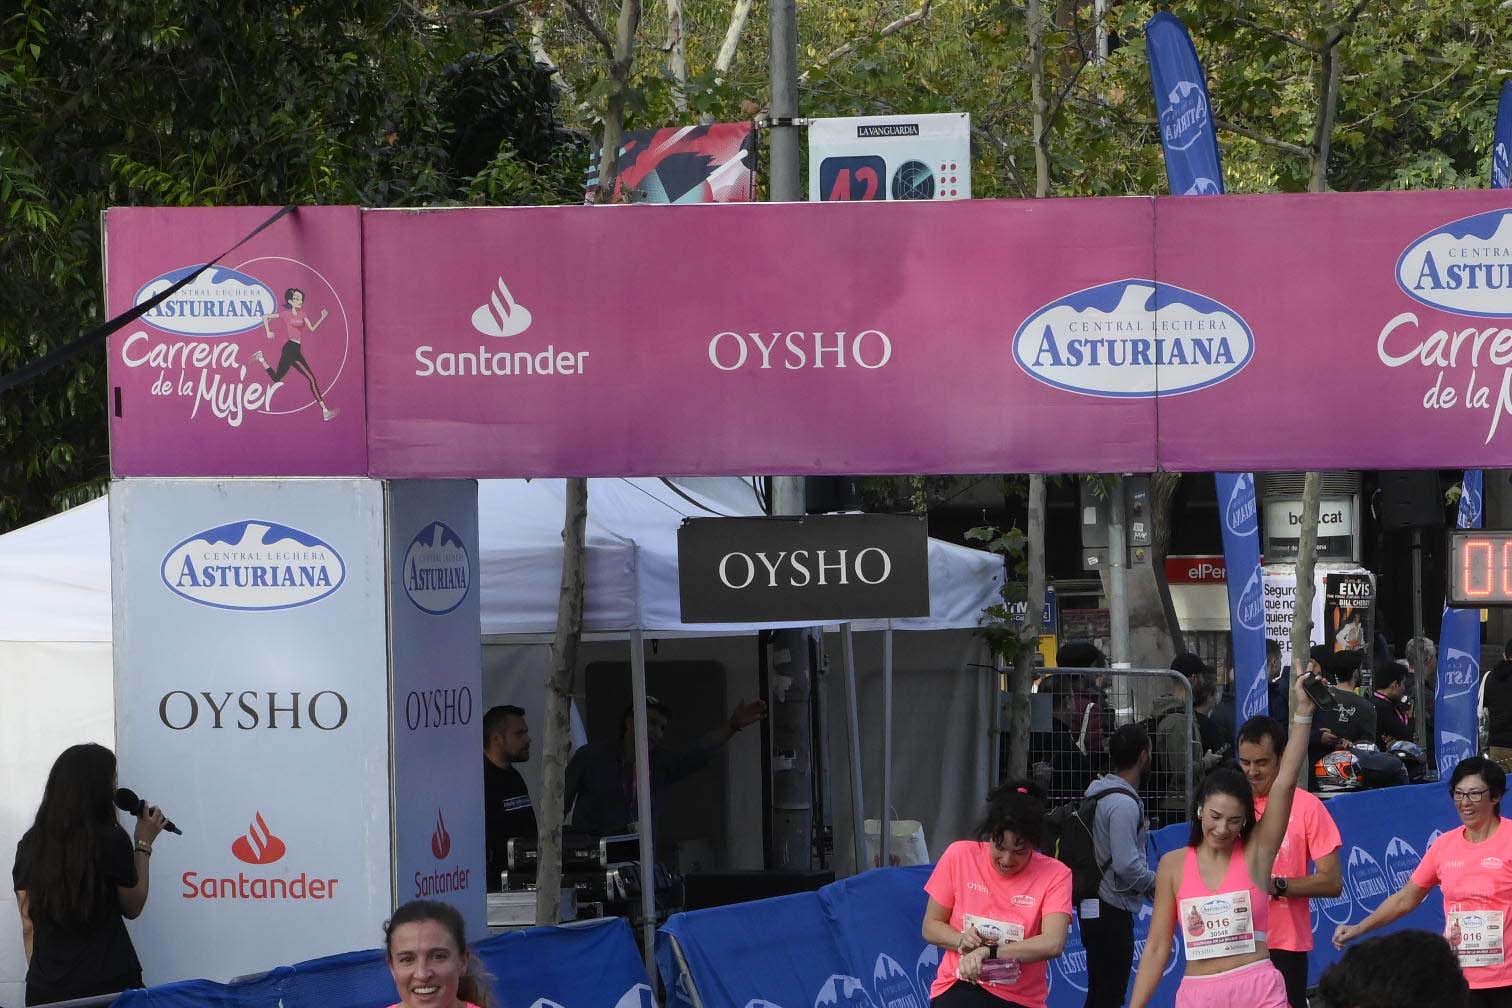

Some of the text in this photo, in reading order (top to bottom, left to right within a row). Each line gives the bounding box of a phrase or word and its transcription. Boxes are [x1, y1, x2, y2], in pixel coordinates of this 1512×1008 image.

[147, 290, 265, 317] ASTURIANA
[174, 288, 211, 296] ENTRAL
[1069, 319, 1227, 332] CENTRAL LECHERA
[122, 331, 242, 369] Carrera
[415, 344, 590, 377] Santander
[708, 330, 892, 371] OYSHO
[1032, 325, 1235, 368] ASTURIANA
[151, 365, 284, 426] de la Mujer
[1423, 369, 1458, 410] de
[1465, 370, 1490, 410] la
[176, 554, 331, 588] ASTURIANA
[203, 551, 326, 561] CENTRAL LECHERA
[719, 547, 892, 589] OYSHO
[408, 556, 466, 591] ASTURIANA
[1340, 583, 1369, 595] ELVIS
[159, 690, 348, 730] OYSHO
[405, 686, 473, 731] OYSHO
[182, 872, 338, 900] Santander
[415, 866, 470, 898] Santander
[1206, 918, 1230, 929] 016
[1463, 932, 1482, 941] 016
